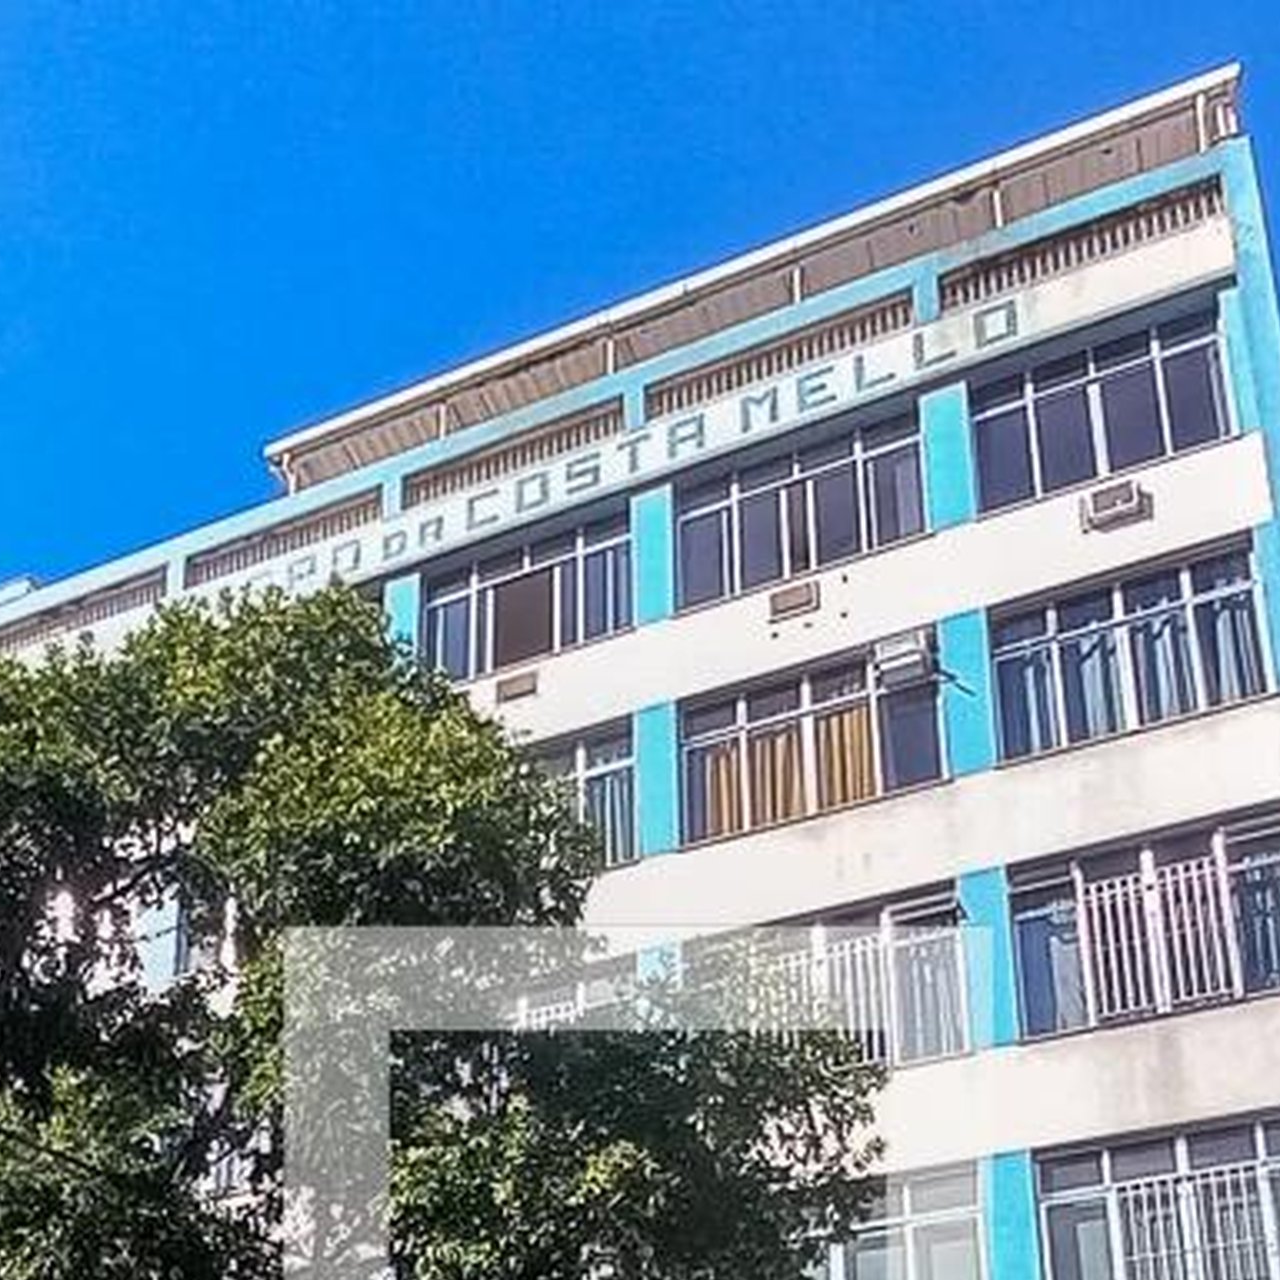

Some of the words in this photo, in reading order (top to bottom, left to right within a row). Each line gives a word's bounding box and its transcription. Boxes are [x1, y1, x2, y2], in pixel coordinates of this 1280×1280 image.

[382, 514, 445, 561] DA
[466, 413, 706, 526] COSTA
[739, 298, 1019, 432] MELLO
